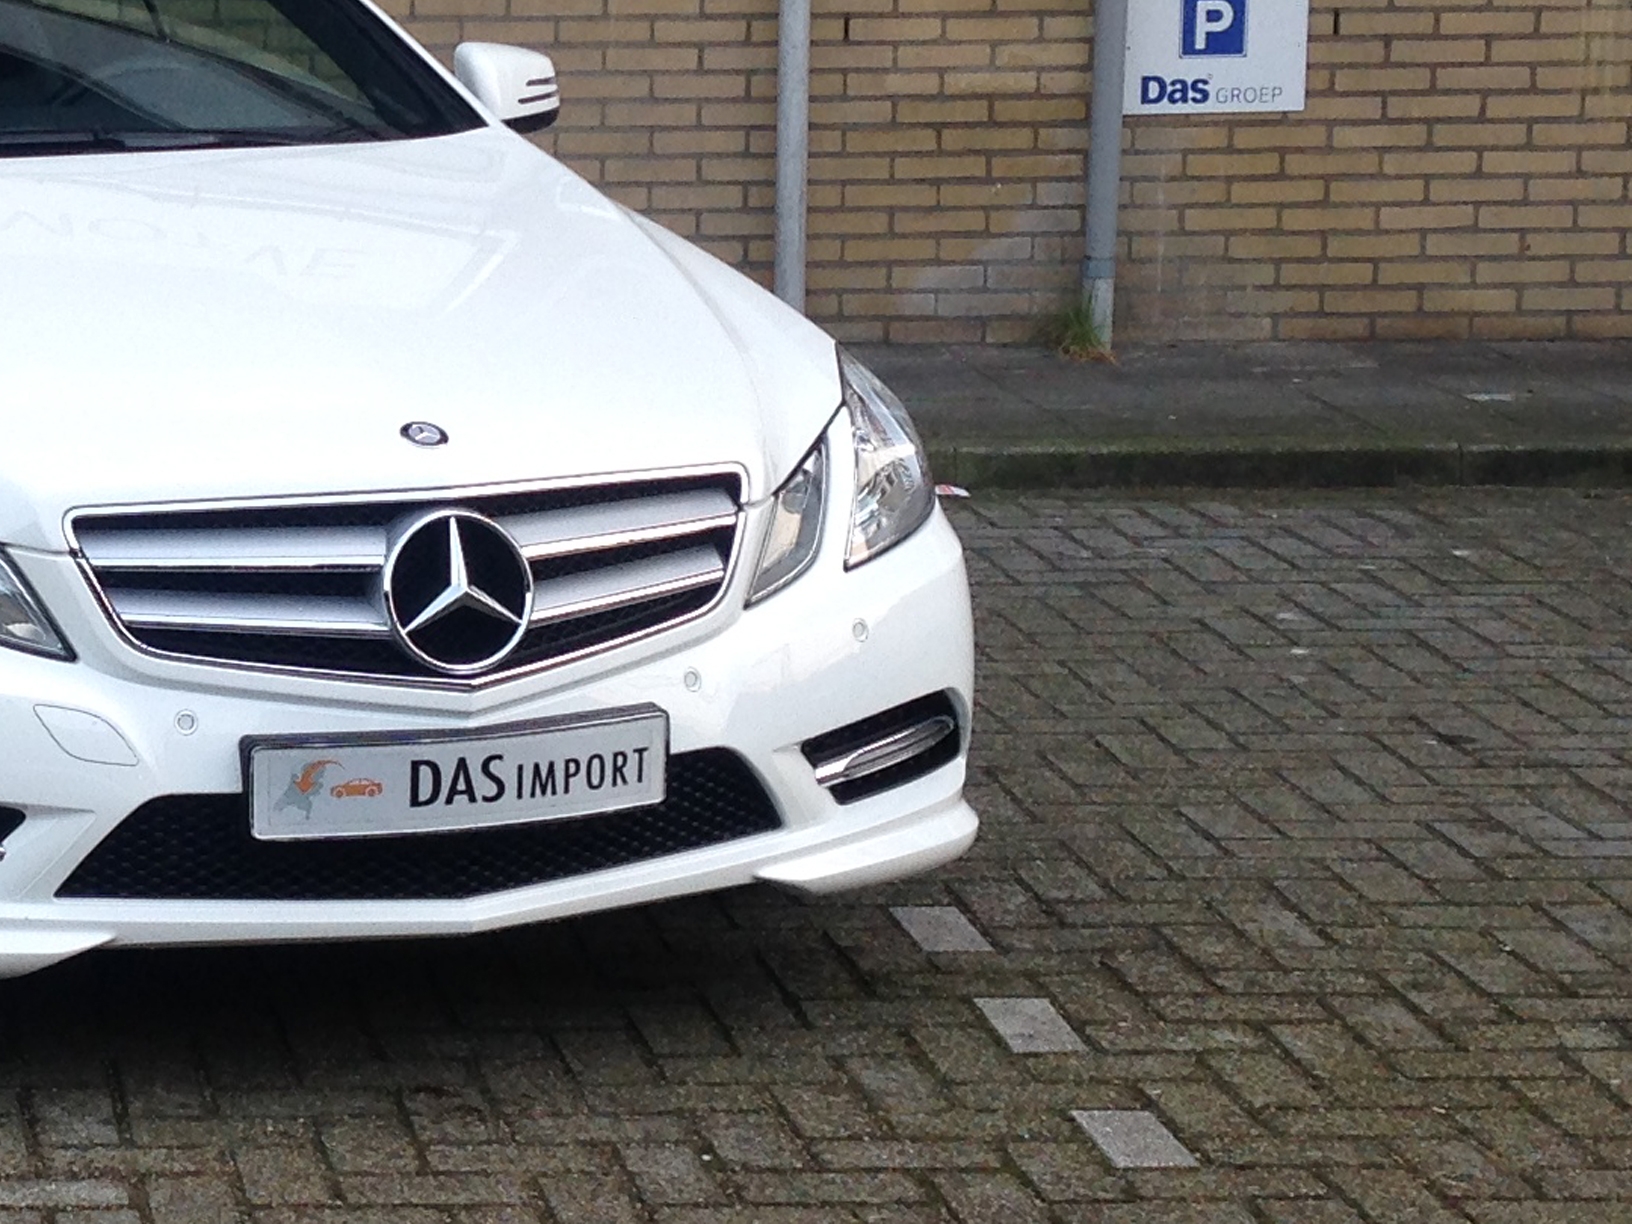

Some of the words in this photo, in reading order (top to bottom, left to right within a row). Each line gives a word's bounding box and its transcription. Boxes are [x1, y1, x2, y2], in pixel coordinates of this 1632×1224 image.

[1194, 0, 1234, 51] P
[1140, 75, 1210, 105] Das
[1215, 86, 1284, 105] GROEP
[409, 753, 506, 808] DAS
[516, 747, 649, 800] IMPORT
